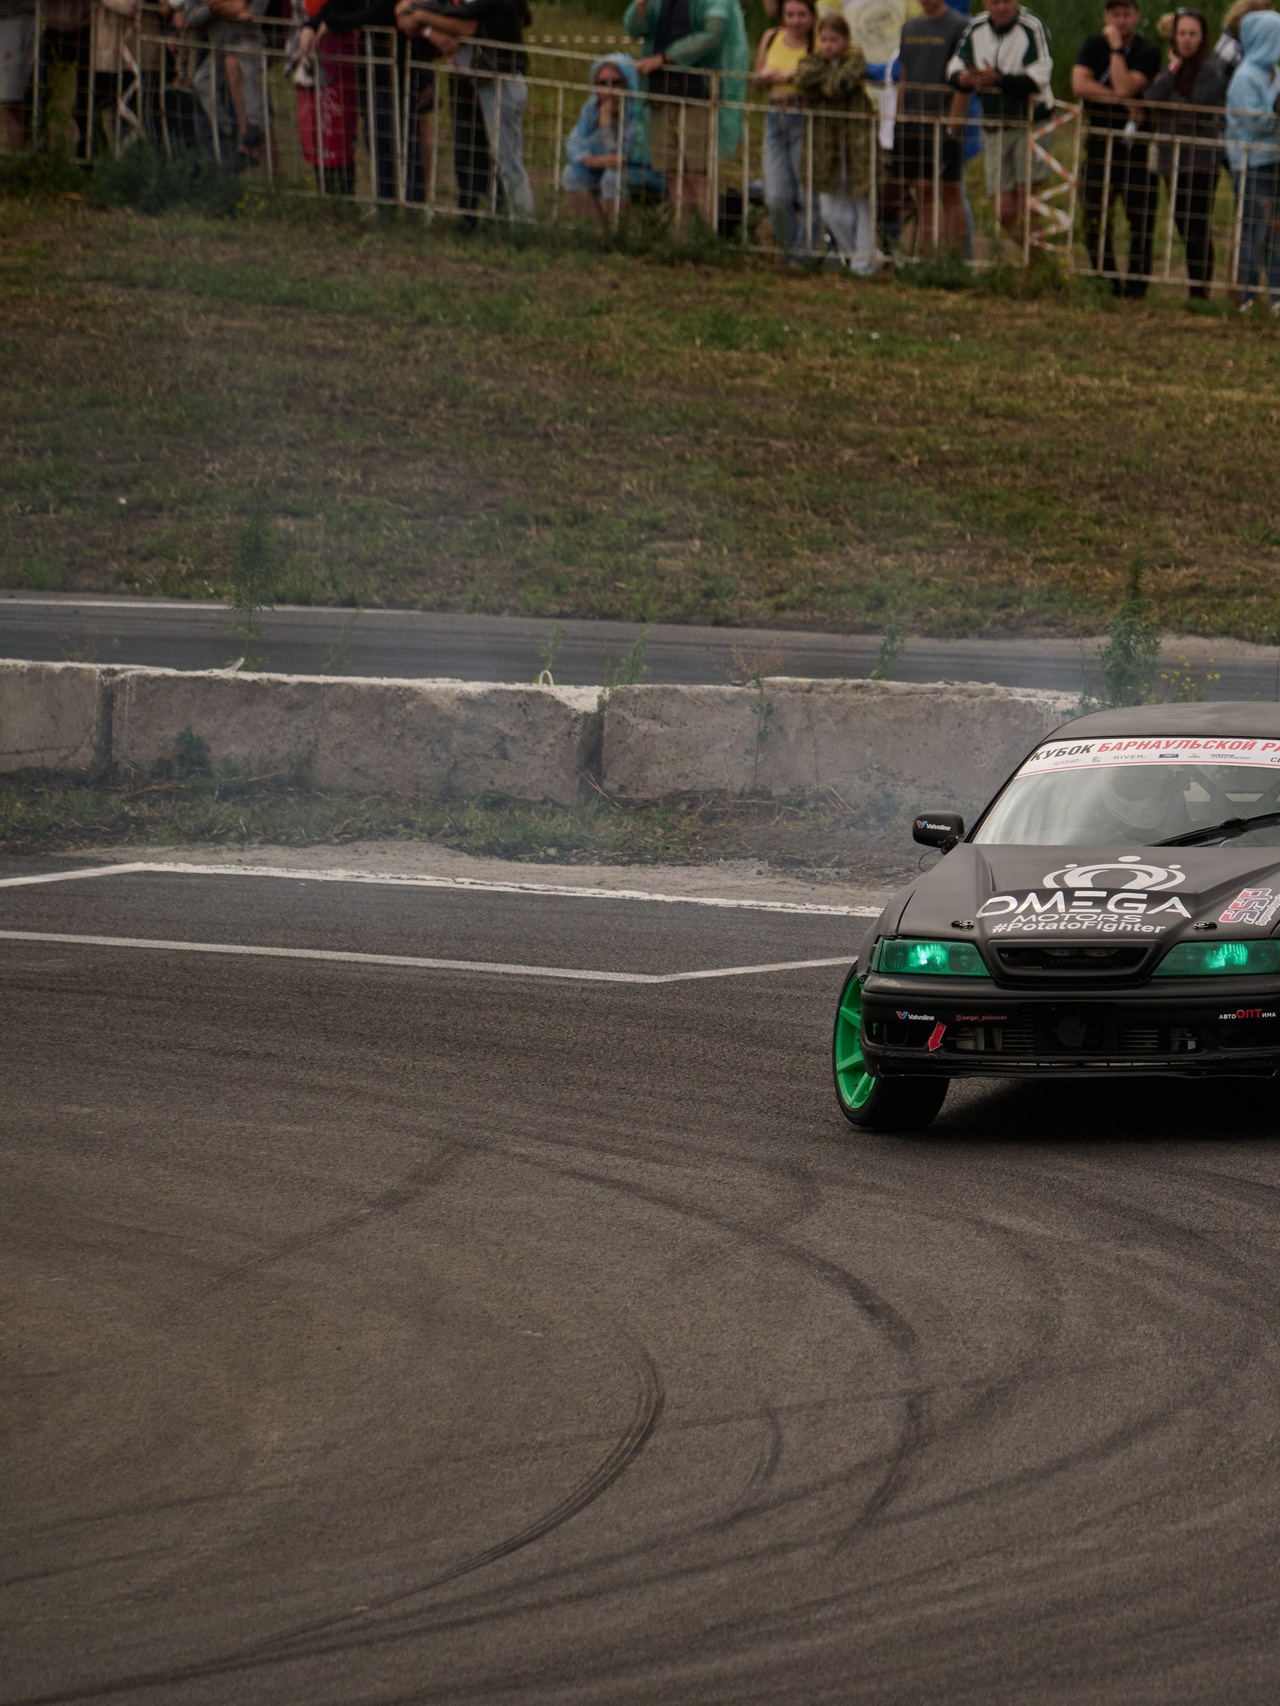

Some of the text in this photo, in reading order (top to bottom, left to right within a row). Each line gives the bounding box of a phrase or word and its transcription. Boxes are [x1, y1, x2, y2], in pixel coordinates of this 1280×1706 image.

[1031, 744, 1096, 762] КУБОК
[1097, 738, 1255, 752] БАРНАУЛЬСКОЙ
[926, 823, 951, 831] Valvoline
[976, 890, 1191, 918] OMEGA
[1012, 913, 1142, 923] MOTORS
[992, 921, 1165, 934] #PotatoFighter
